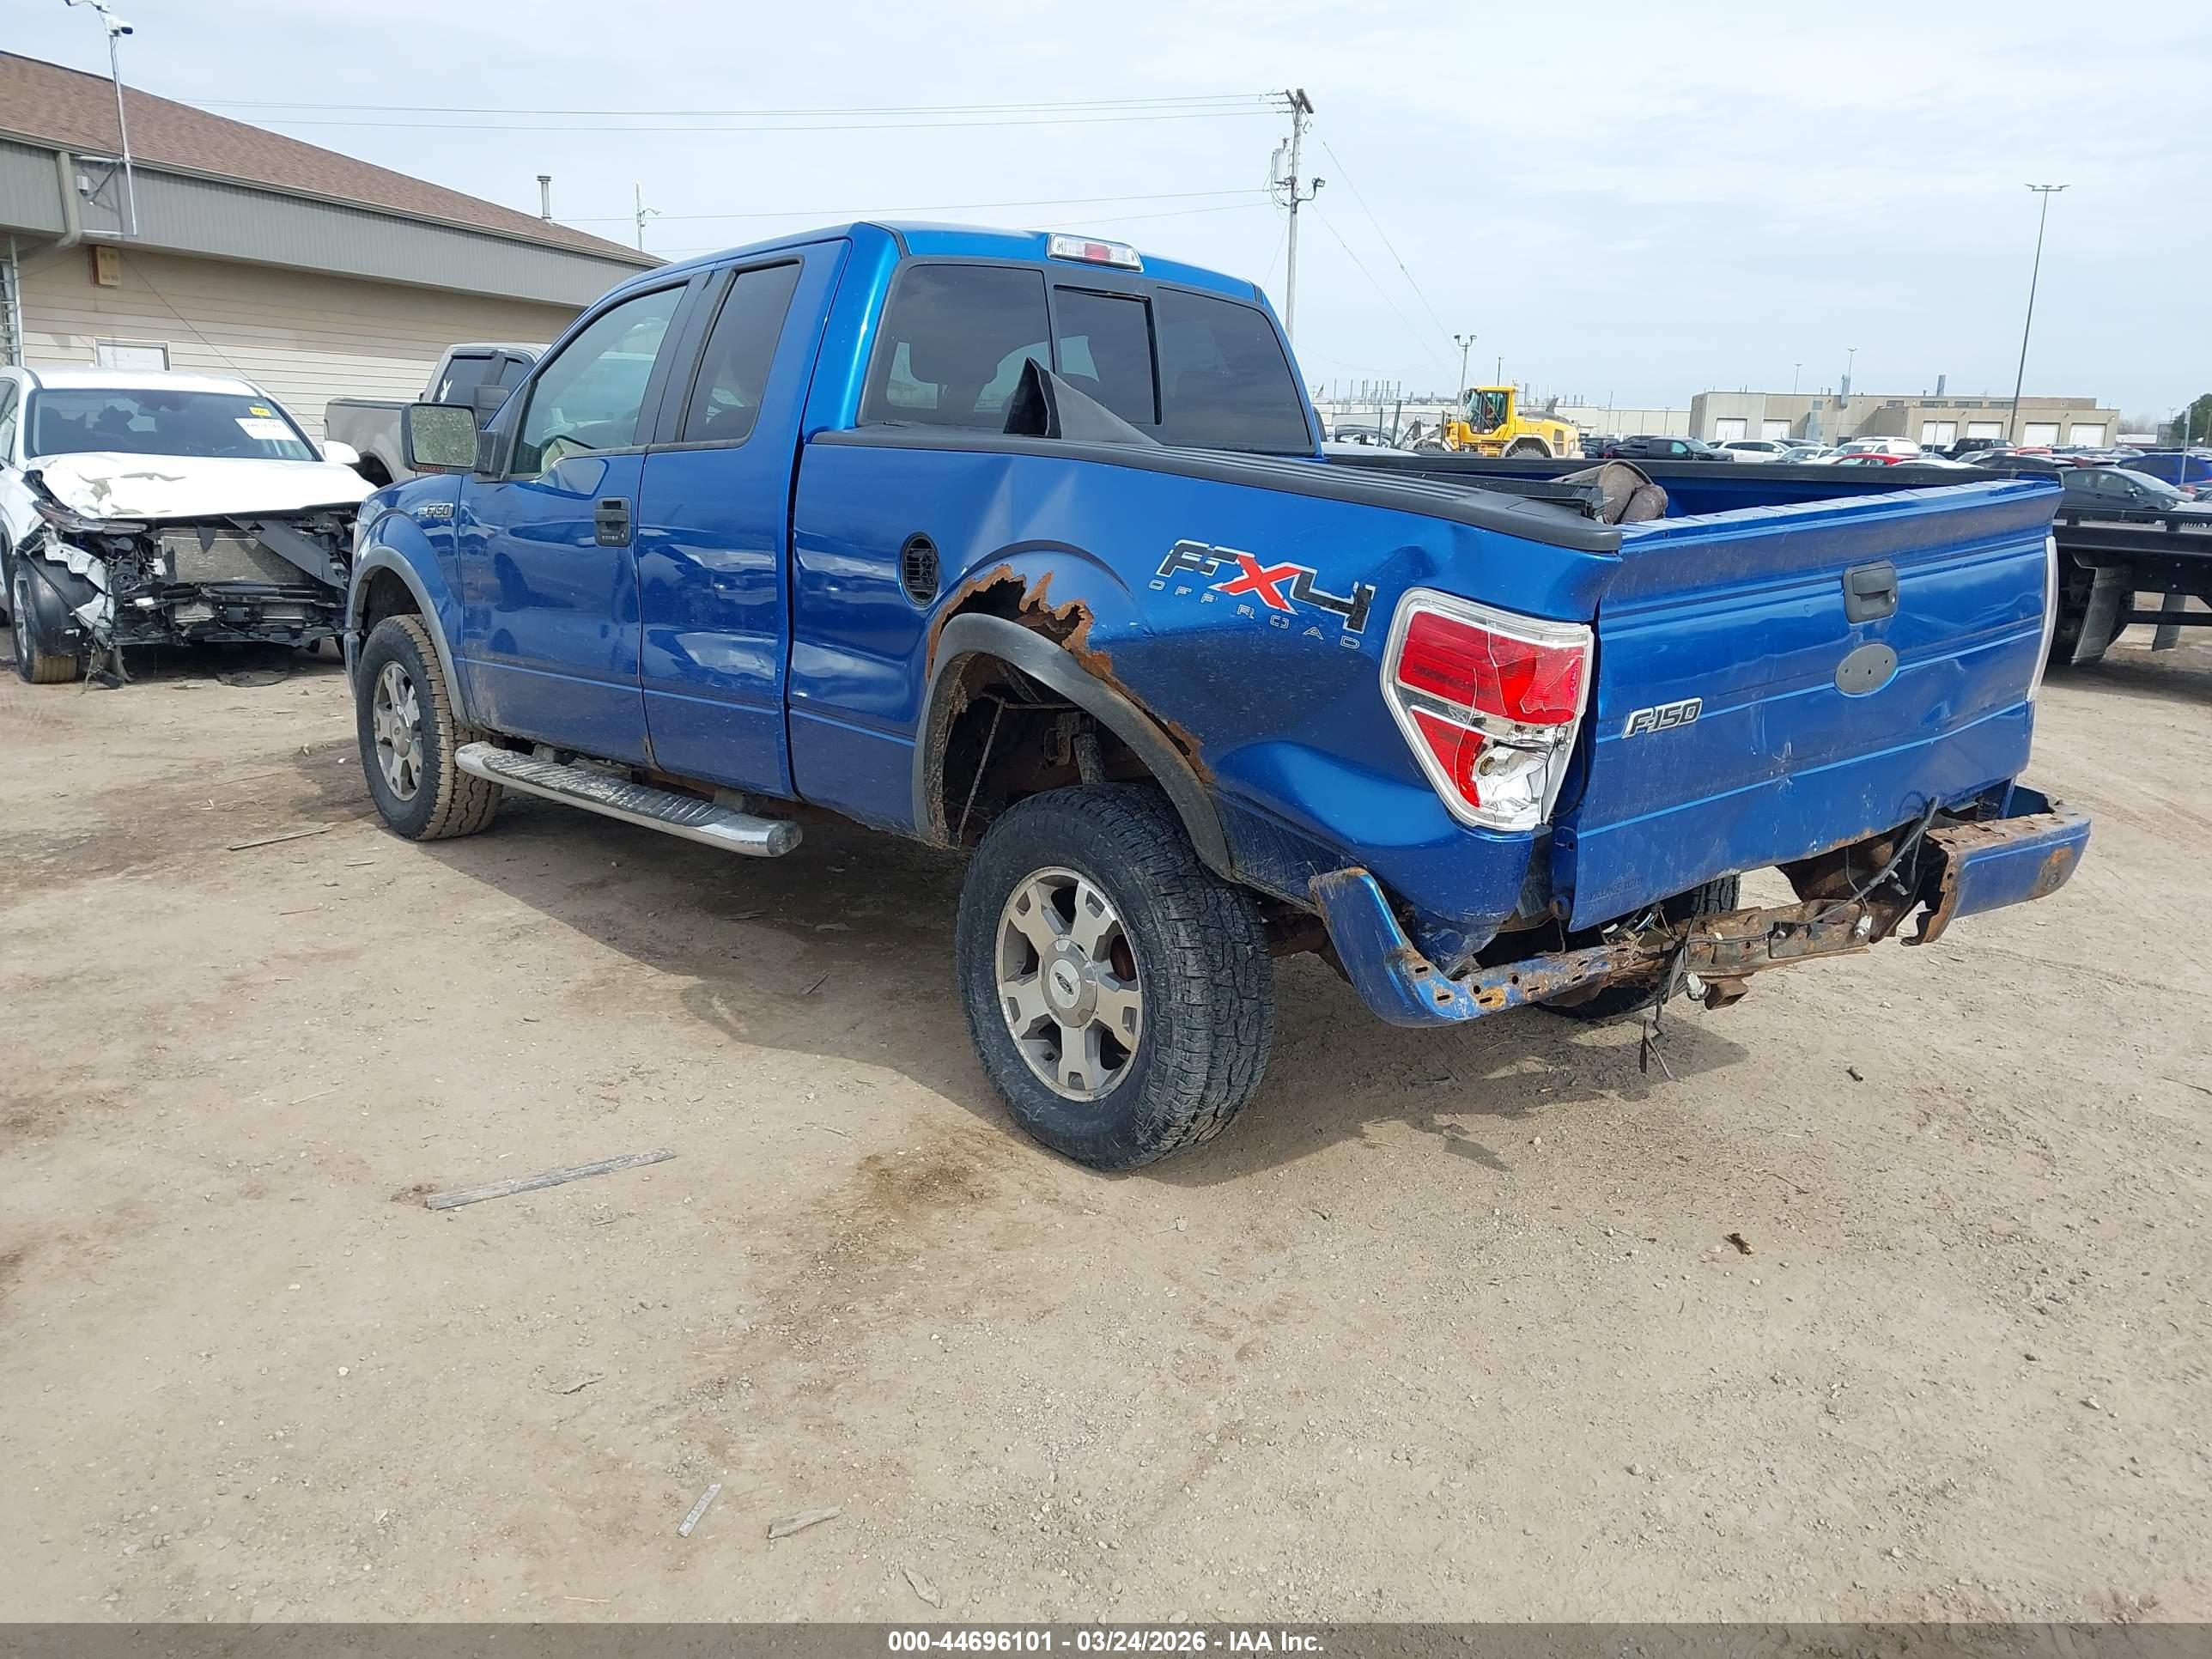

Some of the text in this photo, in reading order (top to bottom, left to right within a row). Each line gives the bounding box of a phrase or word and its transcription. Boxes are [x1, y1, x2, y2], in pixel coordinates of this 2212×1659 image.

[1148, 579, 1361, 650] OFF ROAD
[1156, 539, 1376, 635] FX4
[1623, 698, 1703, 738] F-150
